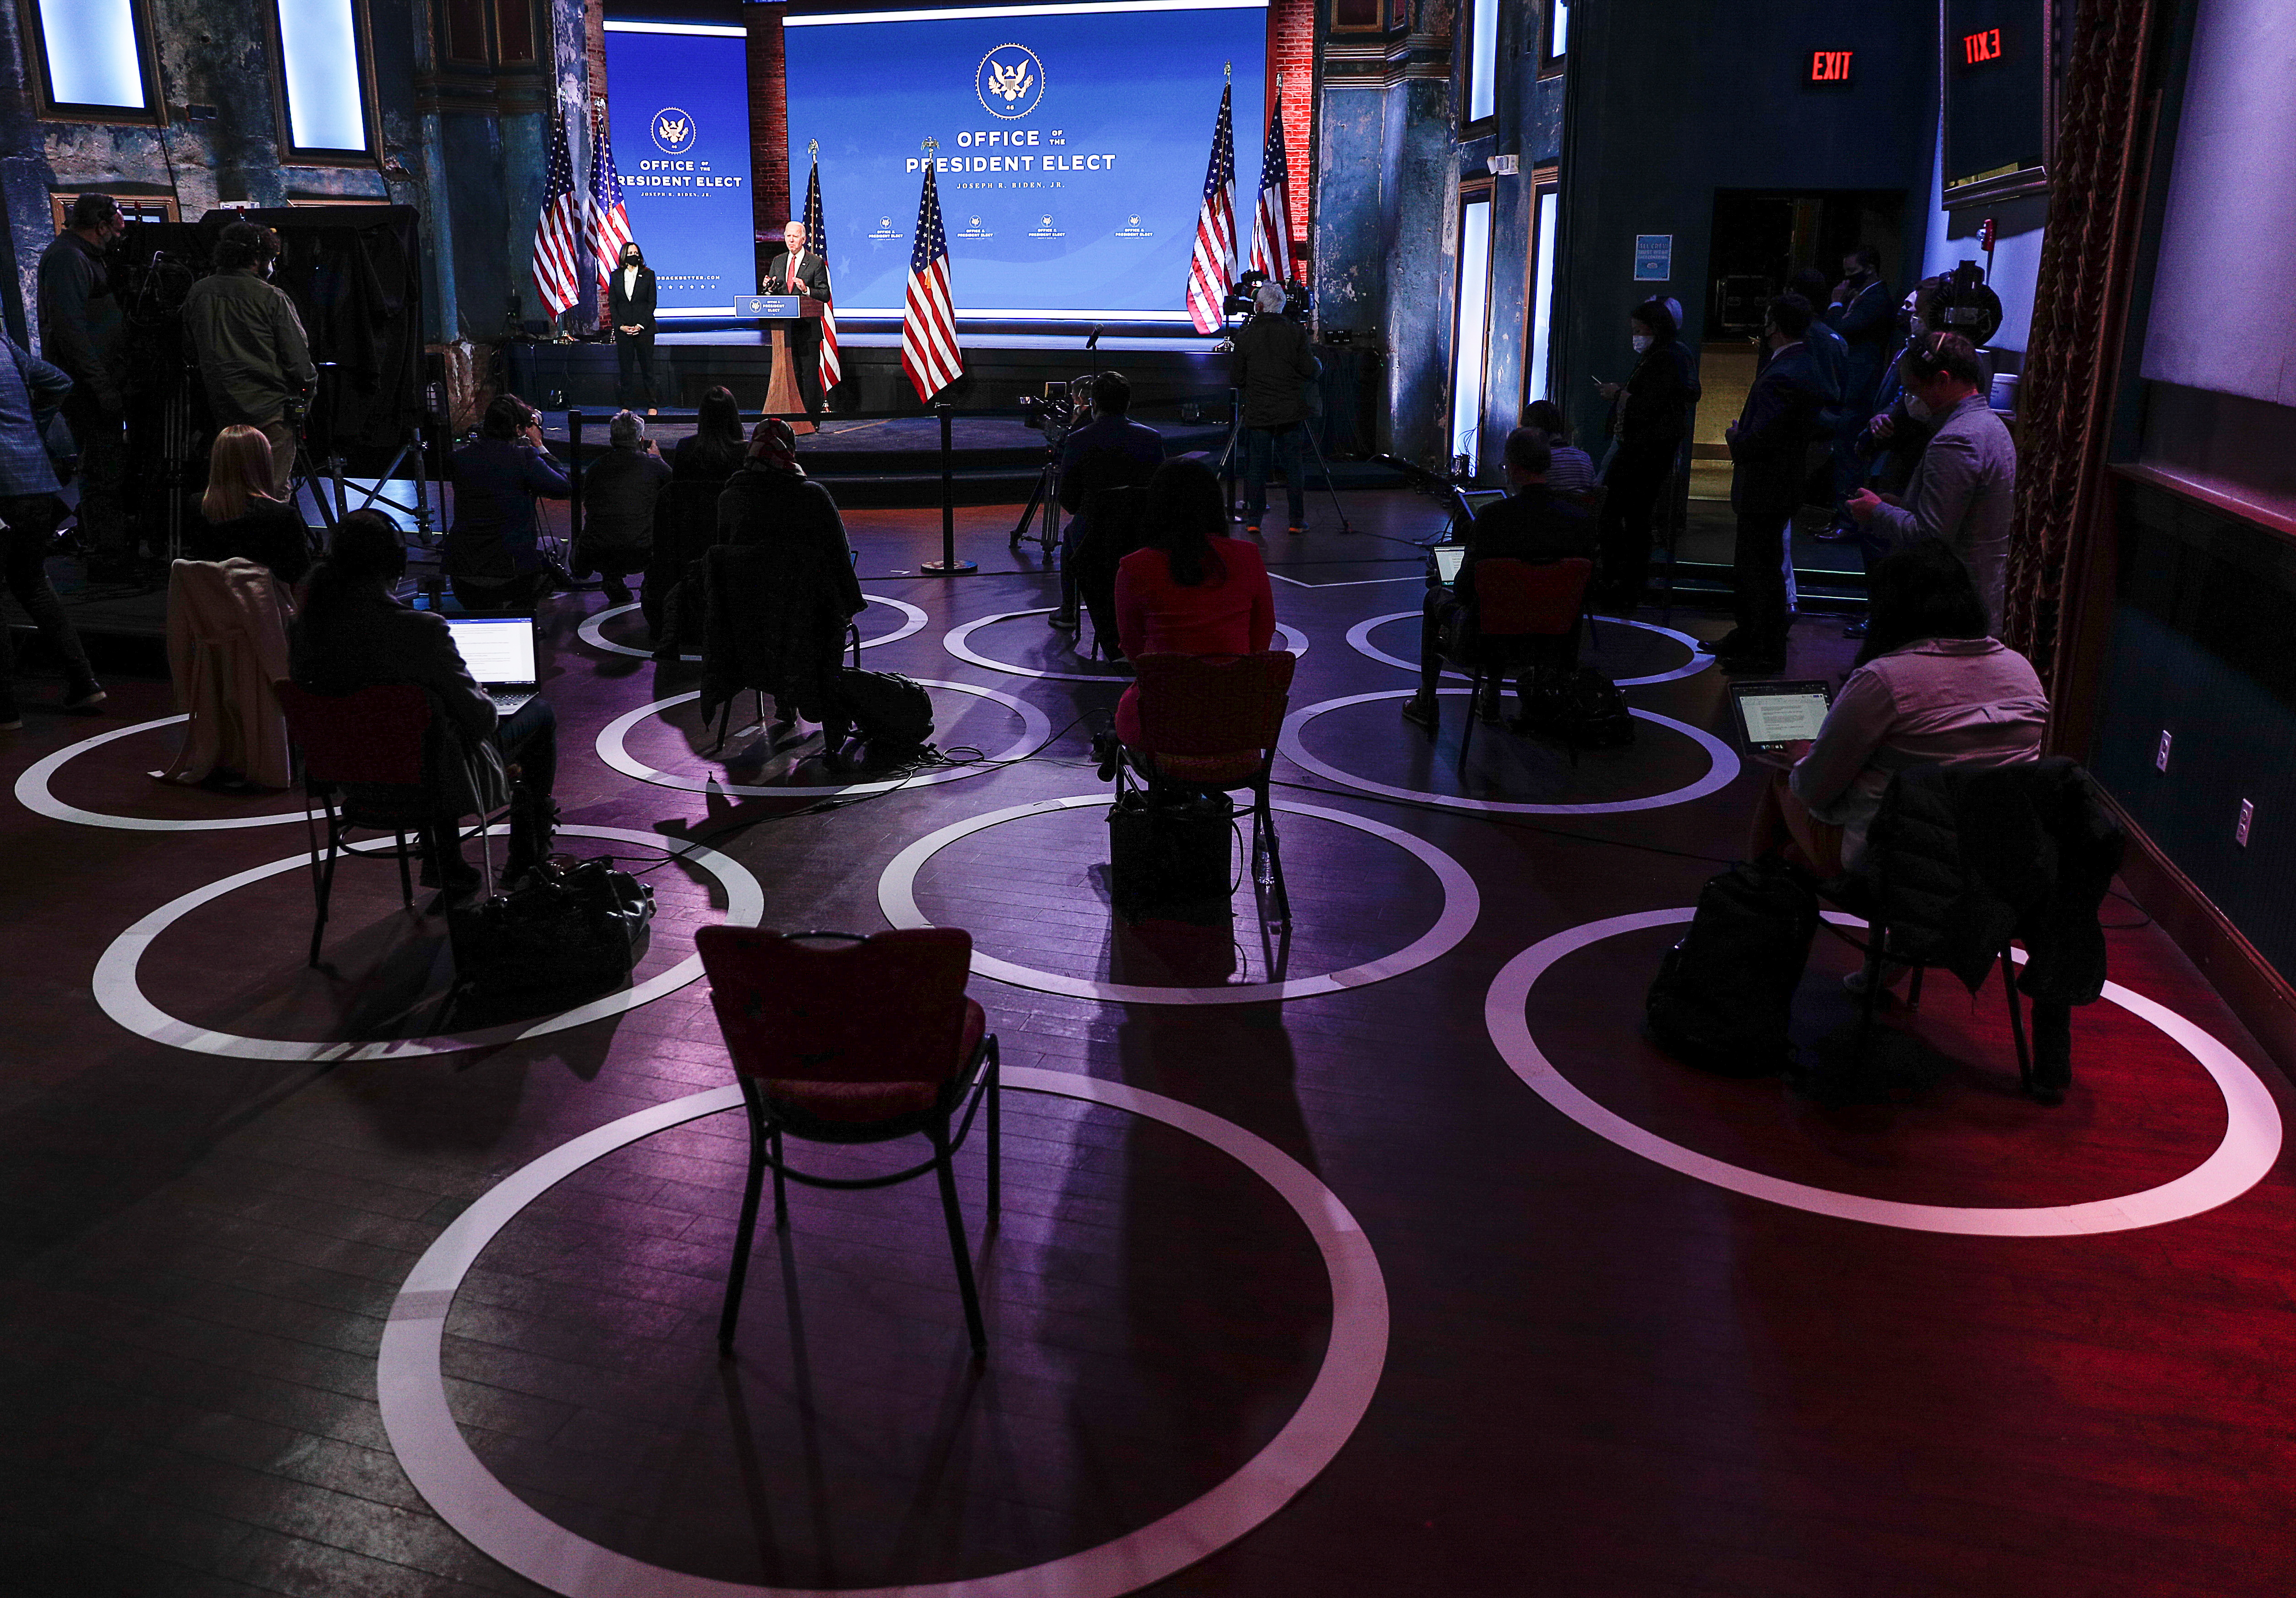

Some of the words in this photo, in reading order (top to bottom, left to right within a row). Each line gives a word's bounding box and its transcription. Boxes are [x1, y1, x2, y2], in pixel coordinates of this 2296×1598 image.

[1812, 51, 1853, 80] EXIT
[957, 130, 1039, 147] OFFICE
[640, 160, 694, 171] OFFICE
[1043, 154, 1115, 170] ELECT
[617, 175, 691, 187] RESIDENT
[696, 176, 742, 187] ELECT
